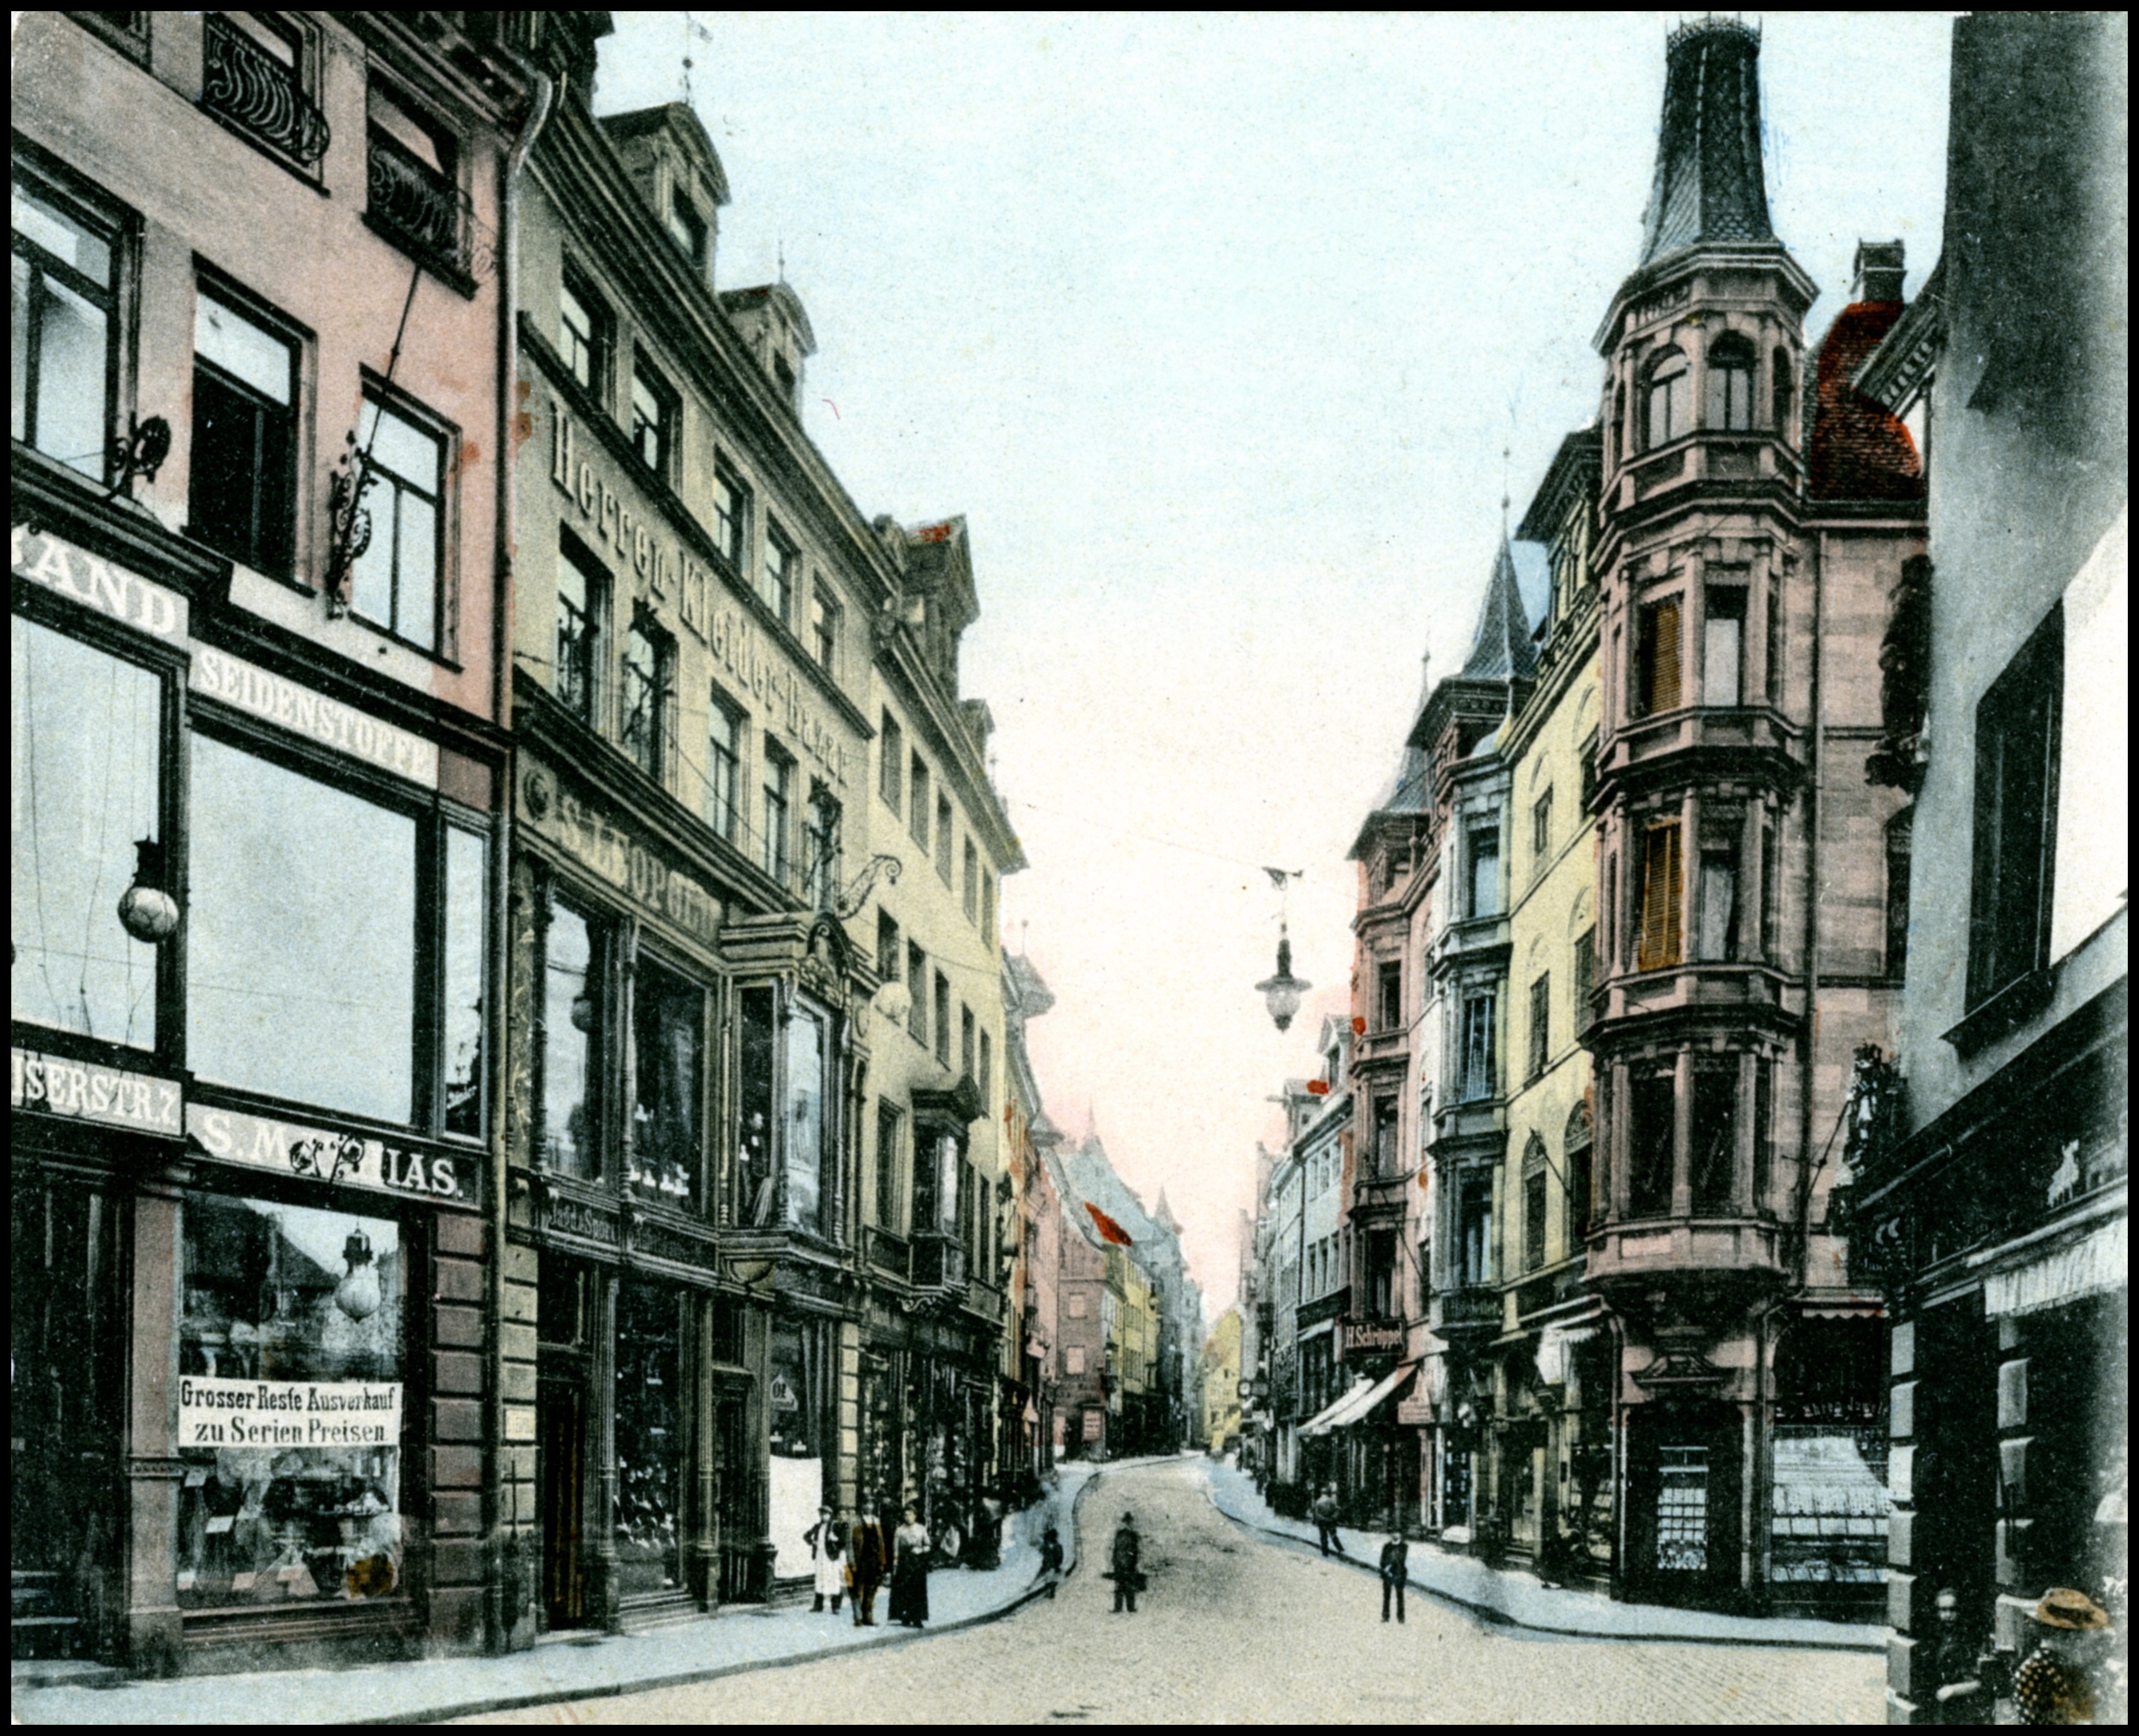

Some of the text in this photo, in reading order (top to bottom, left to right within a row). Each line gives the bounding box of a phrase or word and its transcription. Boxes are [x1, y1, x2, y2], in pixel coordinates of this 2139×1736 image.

[202, 1112, 466, 1198] S. MIAS.
[181, 1379, 395, 1412] Grosser Reste Ausverkauf
[195, 1423, 224, 1442] zu
[231, 1415, 303, 1443] Serien
